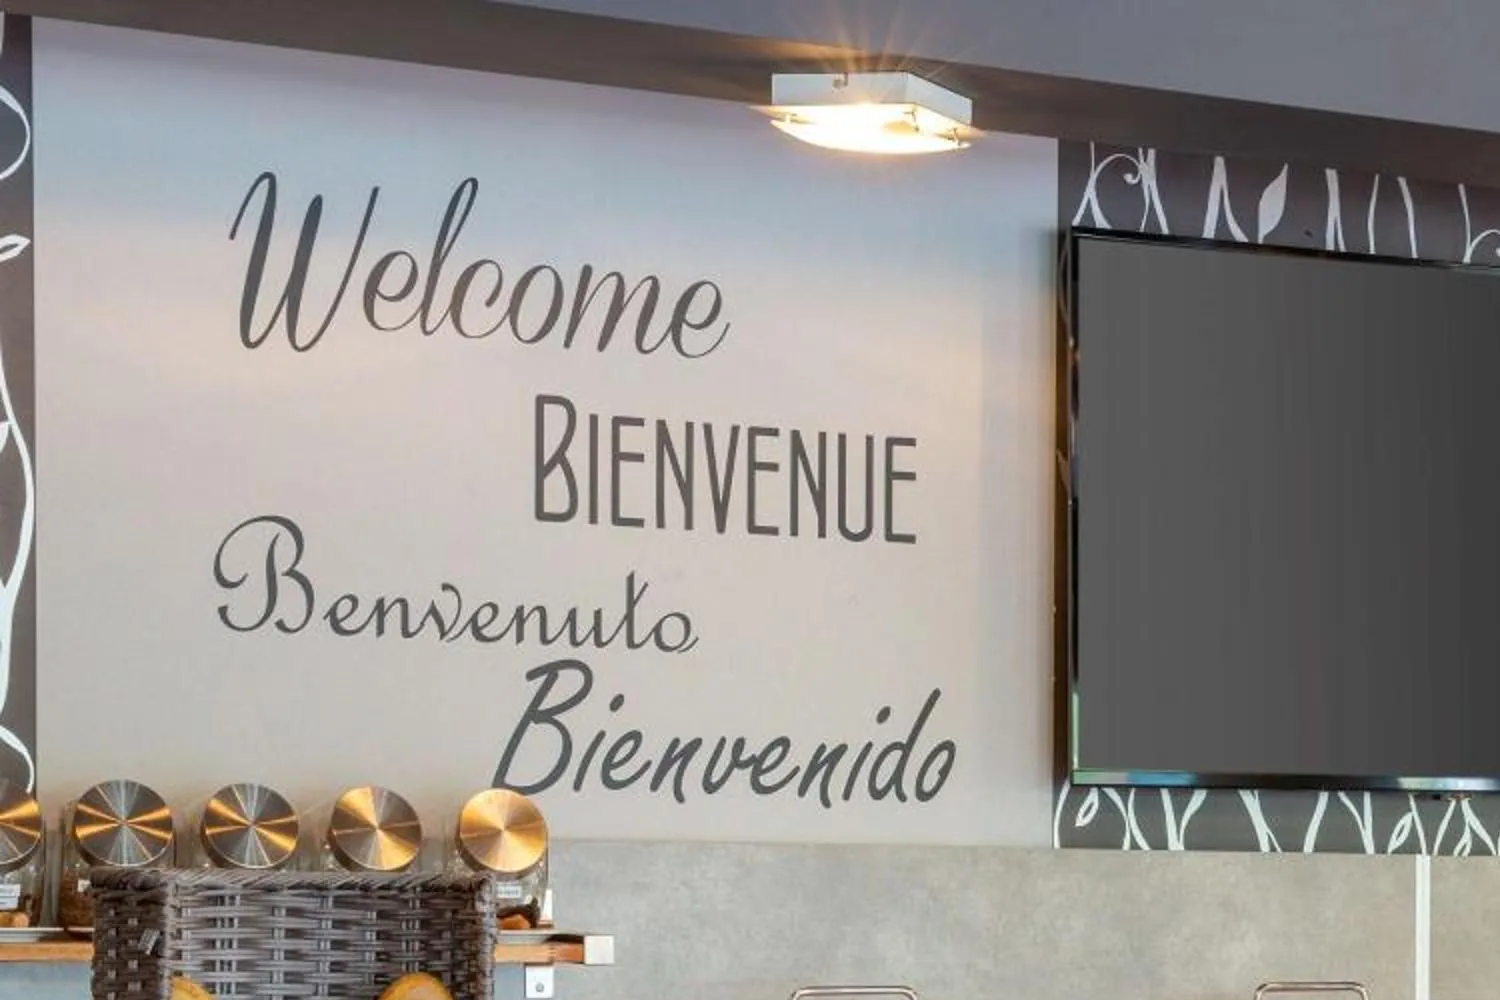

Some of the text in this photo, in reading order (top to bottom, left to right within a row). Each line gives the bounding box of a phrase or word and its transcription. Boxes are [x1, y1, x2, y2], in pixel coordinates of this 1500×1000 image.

[229, 172, 730, 358] Welcome
[534, 394, 917, 544] BIENVENUE
[213, 515, 699, 654] Benvenuto
[491, 659, 956, 809] Bienvenido
